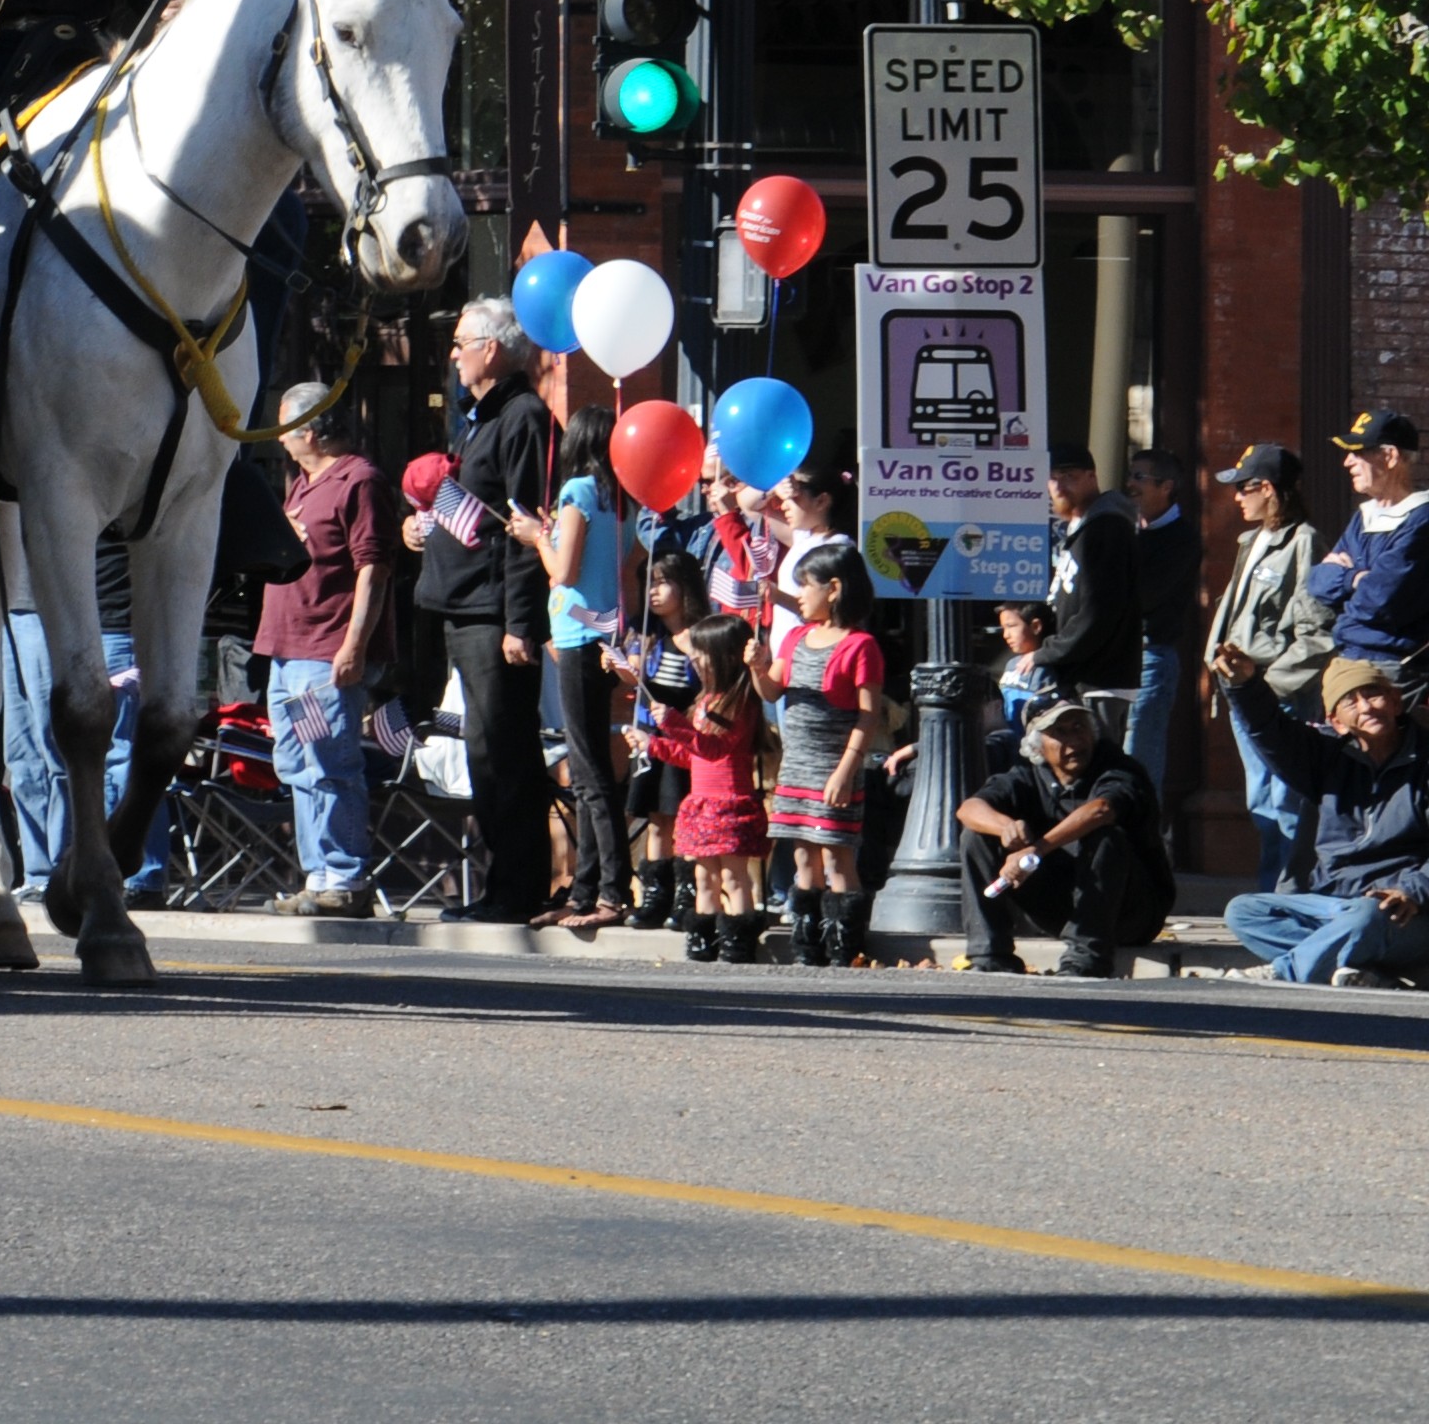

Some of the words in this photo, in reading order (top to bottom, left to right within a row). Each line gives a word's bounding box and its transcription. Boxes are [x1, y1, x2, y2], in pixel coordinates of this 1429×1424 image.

[885, 58, 1024, 94] SPEED
[901, 107, 1008, 142] LIMIT
[889, 155, 1025, 241] 25
[866, 273, 916, 293] Van
[923, 274, 957, 294] Go
[962, 274, 1014, 300] Stop
[1019, 275, 1034, 295] 2
[877, 460, 933, 480] Van
[942, 460, 980, 482] Go
[988, 462, 1035, 483] Bus
[868, 486, 916, 500] Explore
[919, 487, 940, 498] the
[942, 487, 991, 499] Creative
[994, 488, 1043, 500] Corridor
[986, 530, 1044, 553] Free
[970, 558, 1012, 579] Step
[1015, 559, 1044, 576] On
[993, 579, 1008, 595] &
[1013, 579, 1045, 596] Off
